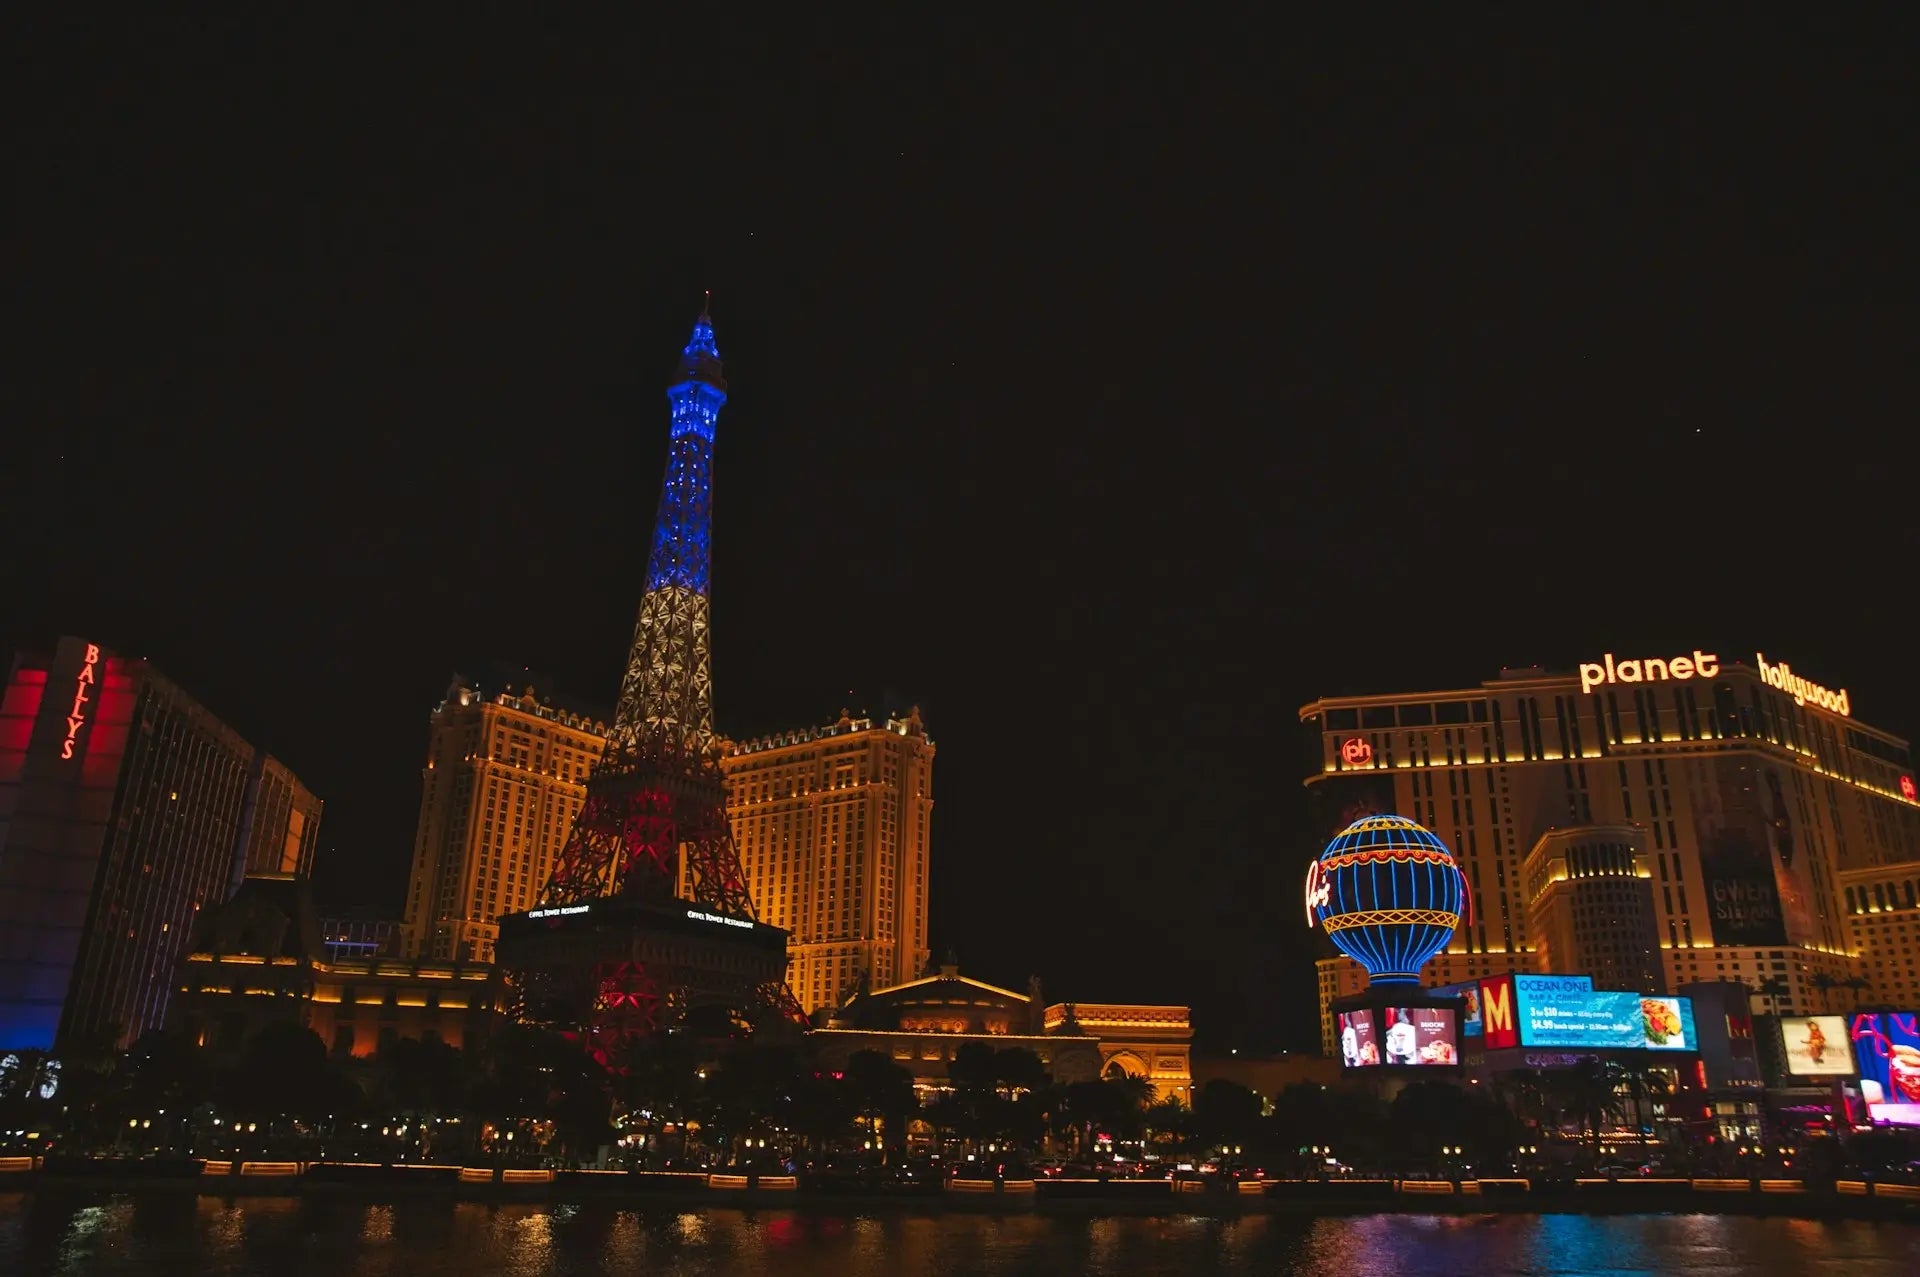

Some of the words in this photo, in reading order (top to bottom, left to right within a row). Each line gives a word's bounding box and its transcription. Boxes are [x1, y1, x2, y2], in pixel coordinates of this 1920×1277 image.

[1579, 650, 1720, 694] planet
[1756, 652, 1850, 716] hollywood
[61, 643, 99, 759] BALLYS
[1346, 738, 1371, 763] ph
[1483, 983, 1512, 1033] M
[1519, 981, 1560, 991] OCEAN
[1563, 981, 1588, 992] ONE
